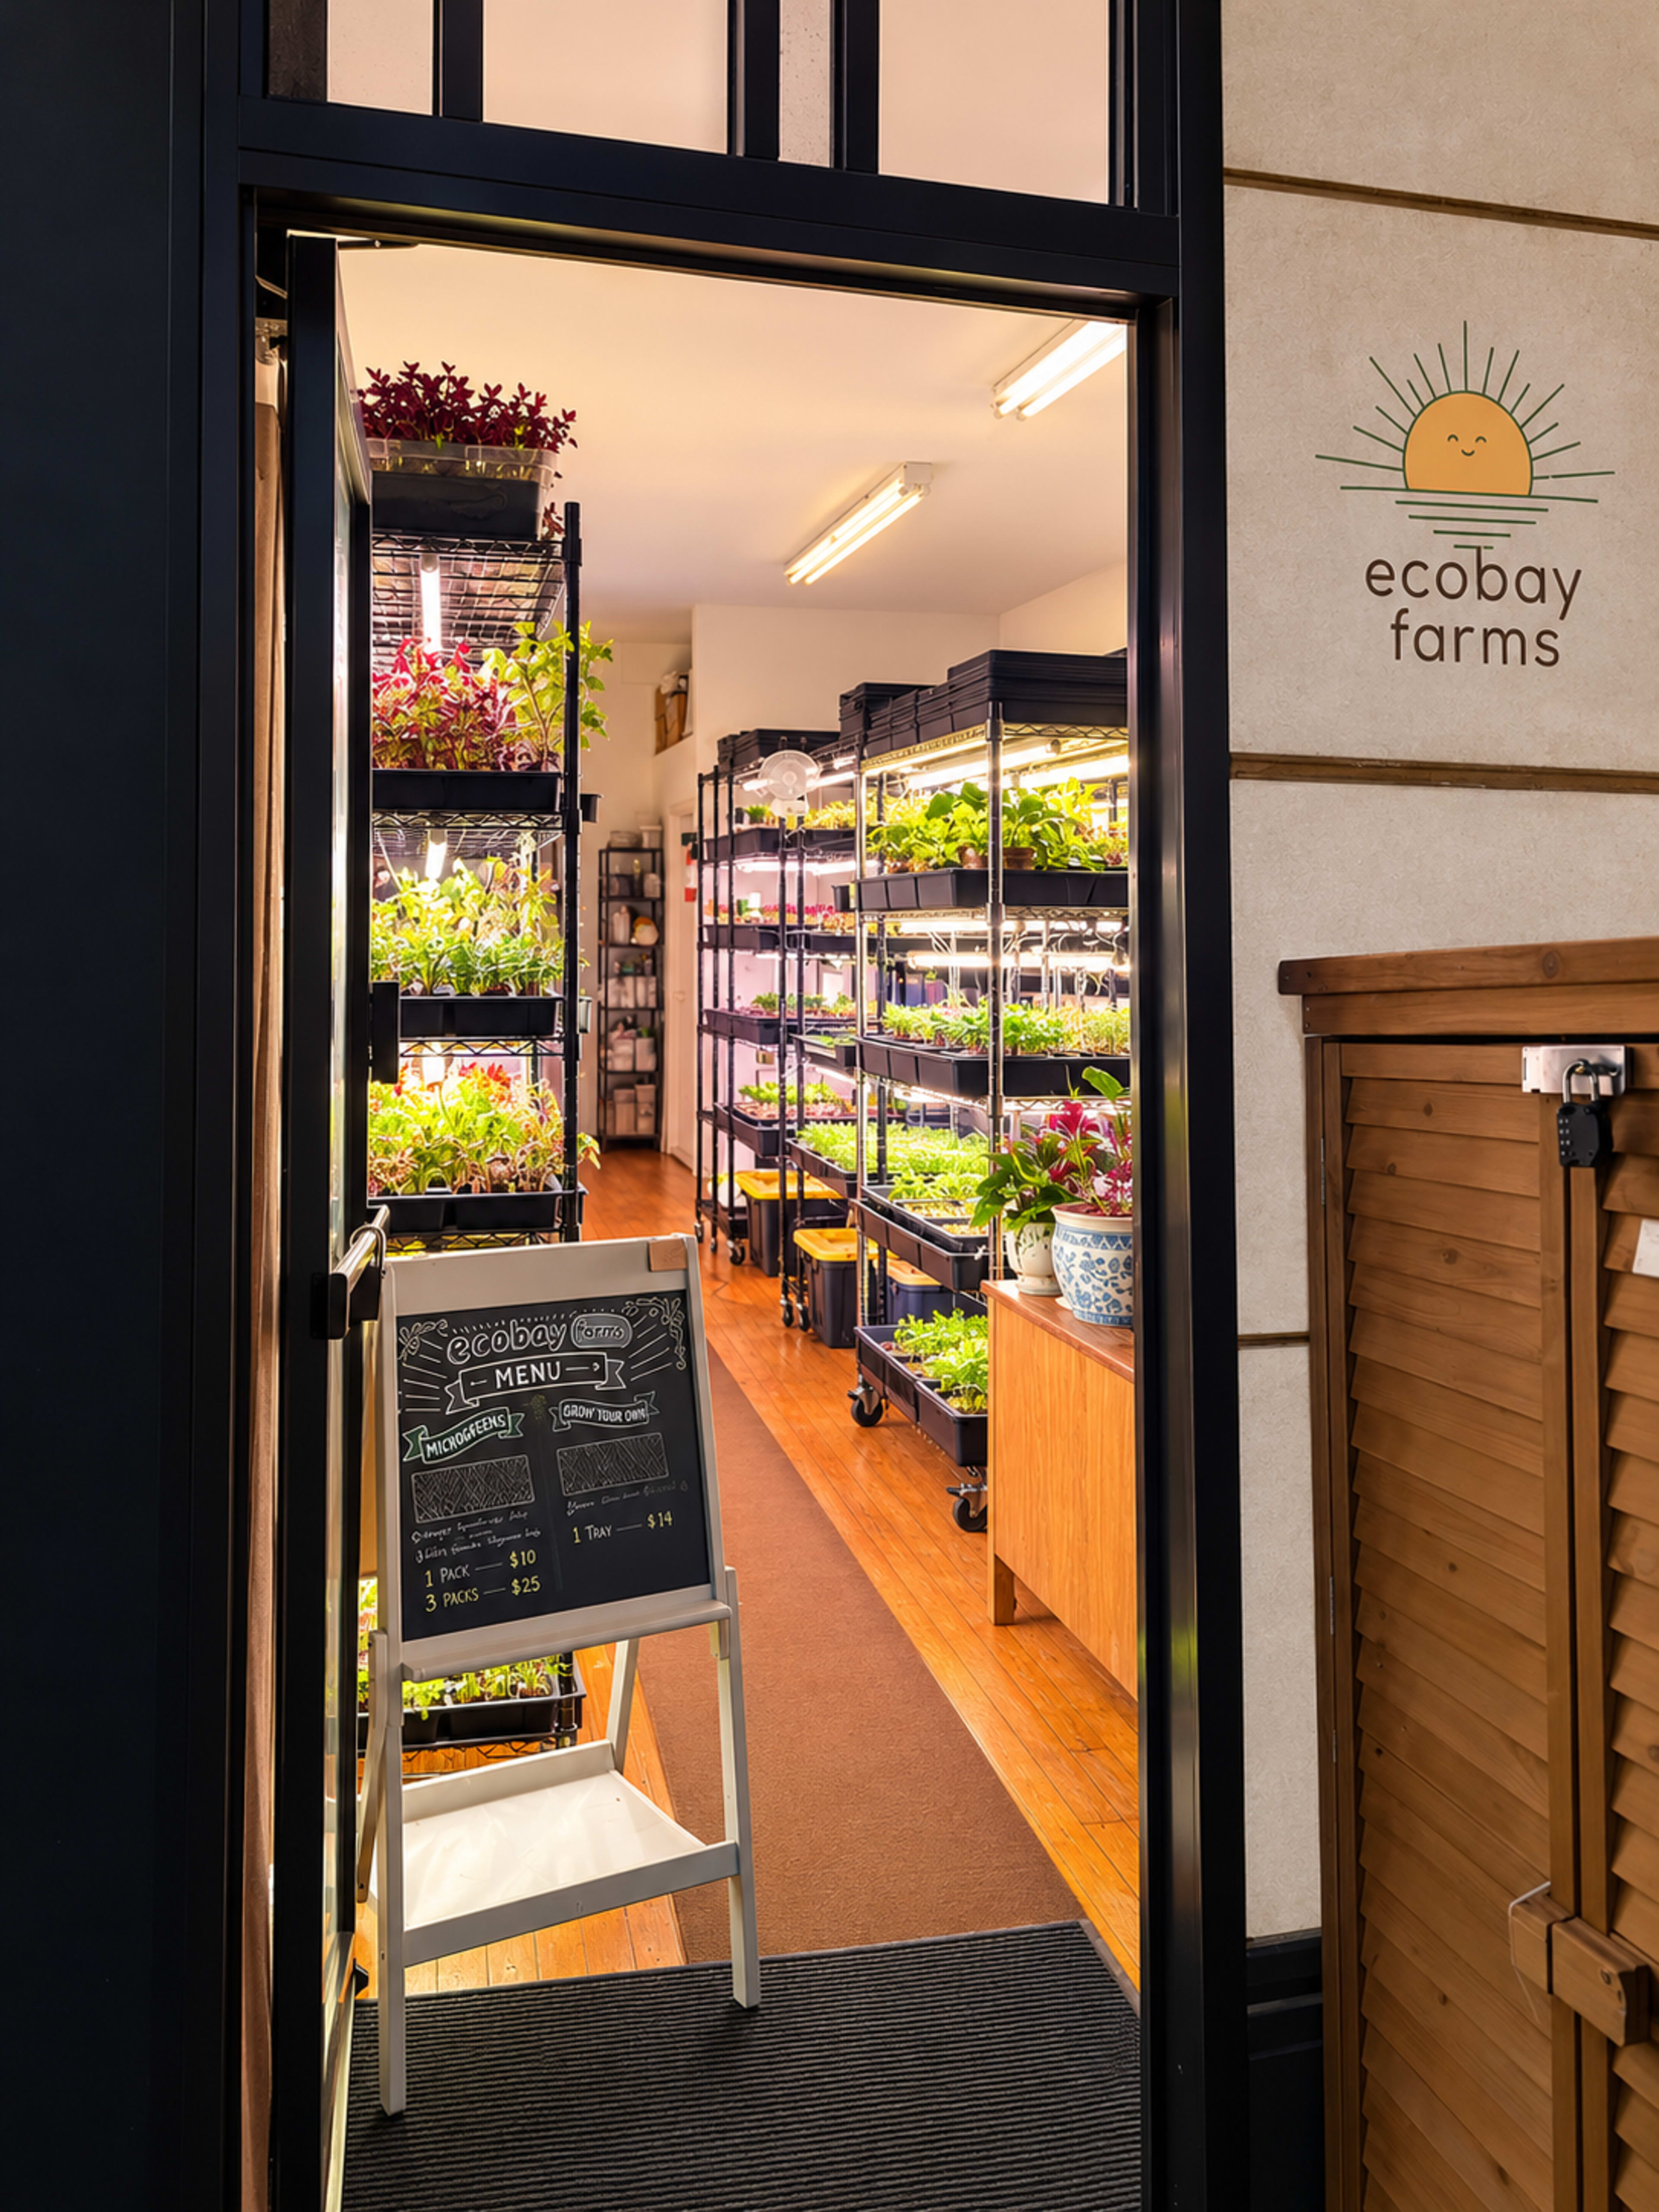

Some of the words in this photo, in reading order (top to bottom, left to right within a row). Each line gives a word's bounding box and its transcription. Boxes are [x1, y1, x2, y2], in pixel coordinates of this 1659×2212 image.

[1365, 547, 1582, 620] ecobay
[1391, 608, 1560, 667] farms
[447, 1319, 567, 1364] ecobay
[495, 1361, 560, 1389] MENU
[572, 1526, 581, 1544] 1
[648, 1511, 673, 1529] $14
[425, 1570, 434, 1588] 1
[440, 1564, 470, 1583] PACK
[509, 1550, 537, 1568] $10
[425, 1594, 437, 1612] 3
[443, 1587, 479, 1608] PACKS
[511, 1575, 540, 1595] $25
